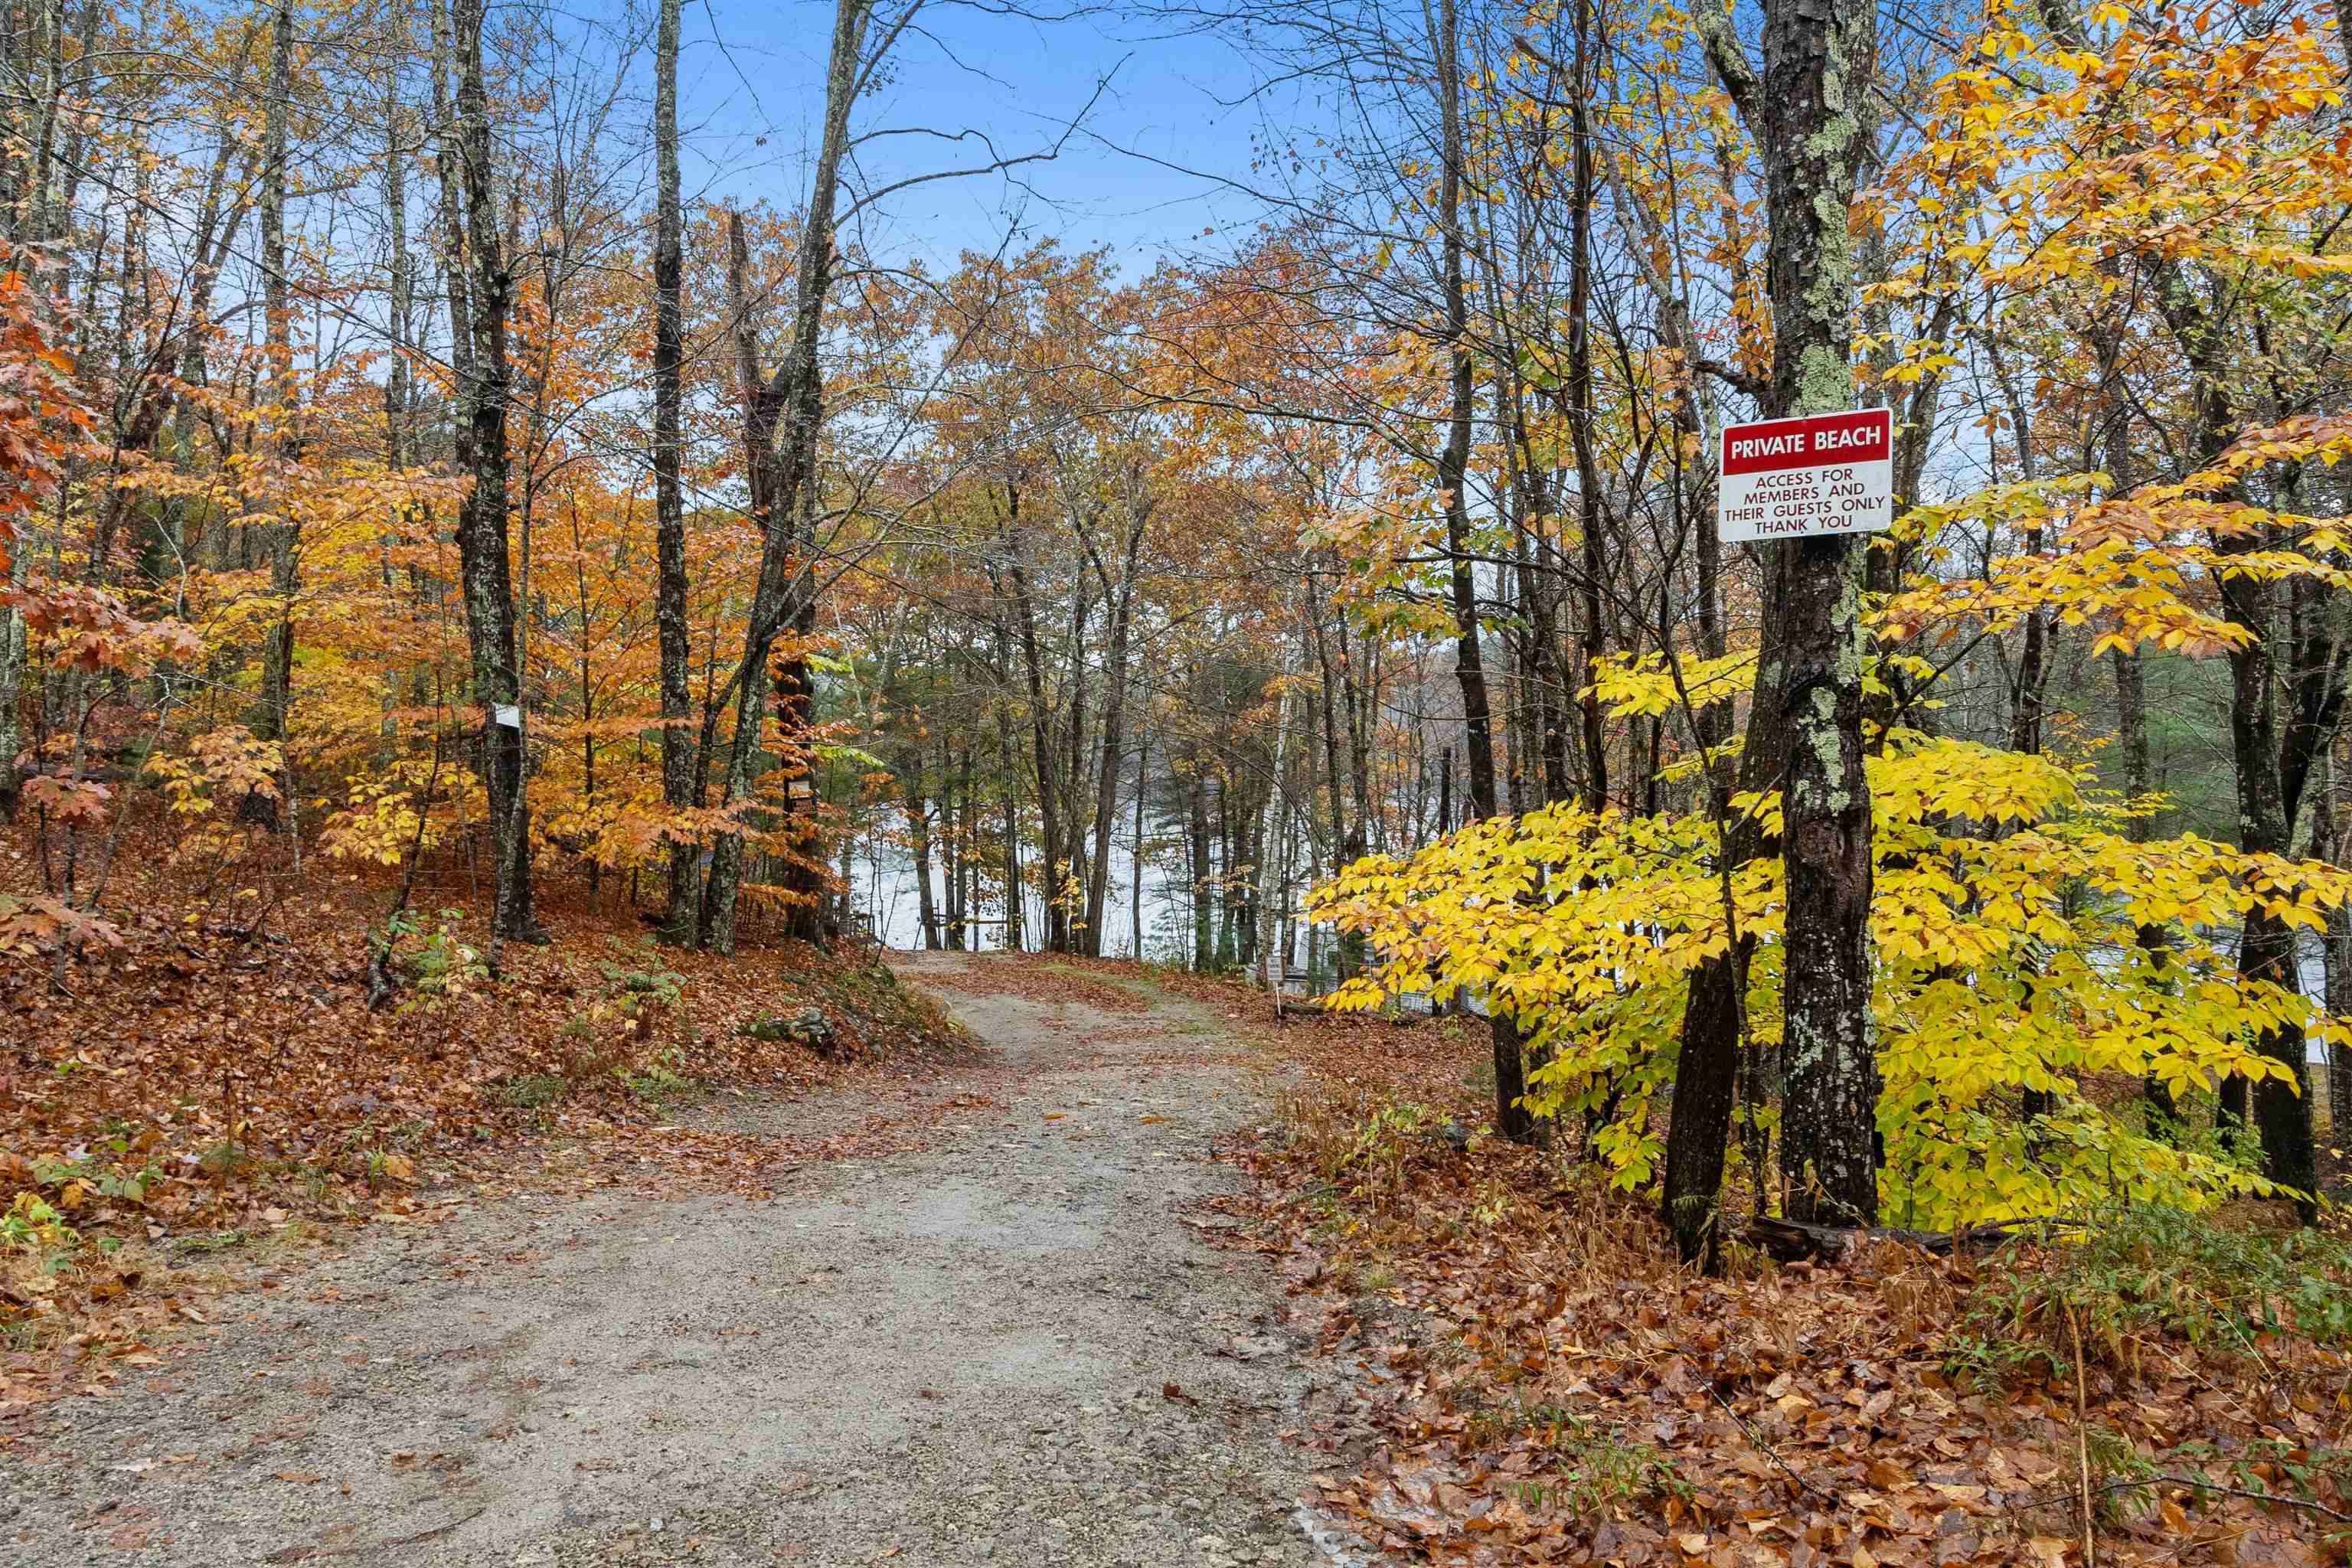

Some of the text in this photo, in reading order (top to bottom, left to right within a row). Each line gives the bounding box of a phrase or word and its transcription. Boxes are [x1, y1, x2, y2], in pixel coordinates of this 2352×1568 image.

[1732, 426, 1881, 459] PRIVATE BEACH
[1755, 468, 1854, 489] ACCESS FOR
[1743, 482, 1865, 505] MEMBERS AND
[1724, 495, 1886, 522] THEIR GUESTS ONLY
[1754, 514, 1853, 534] THANK YOU
